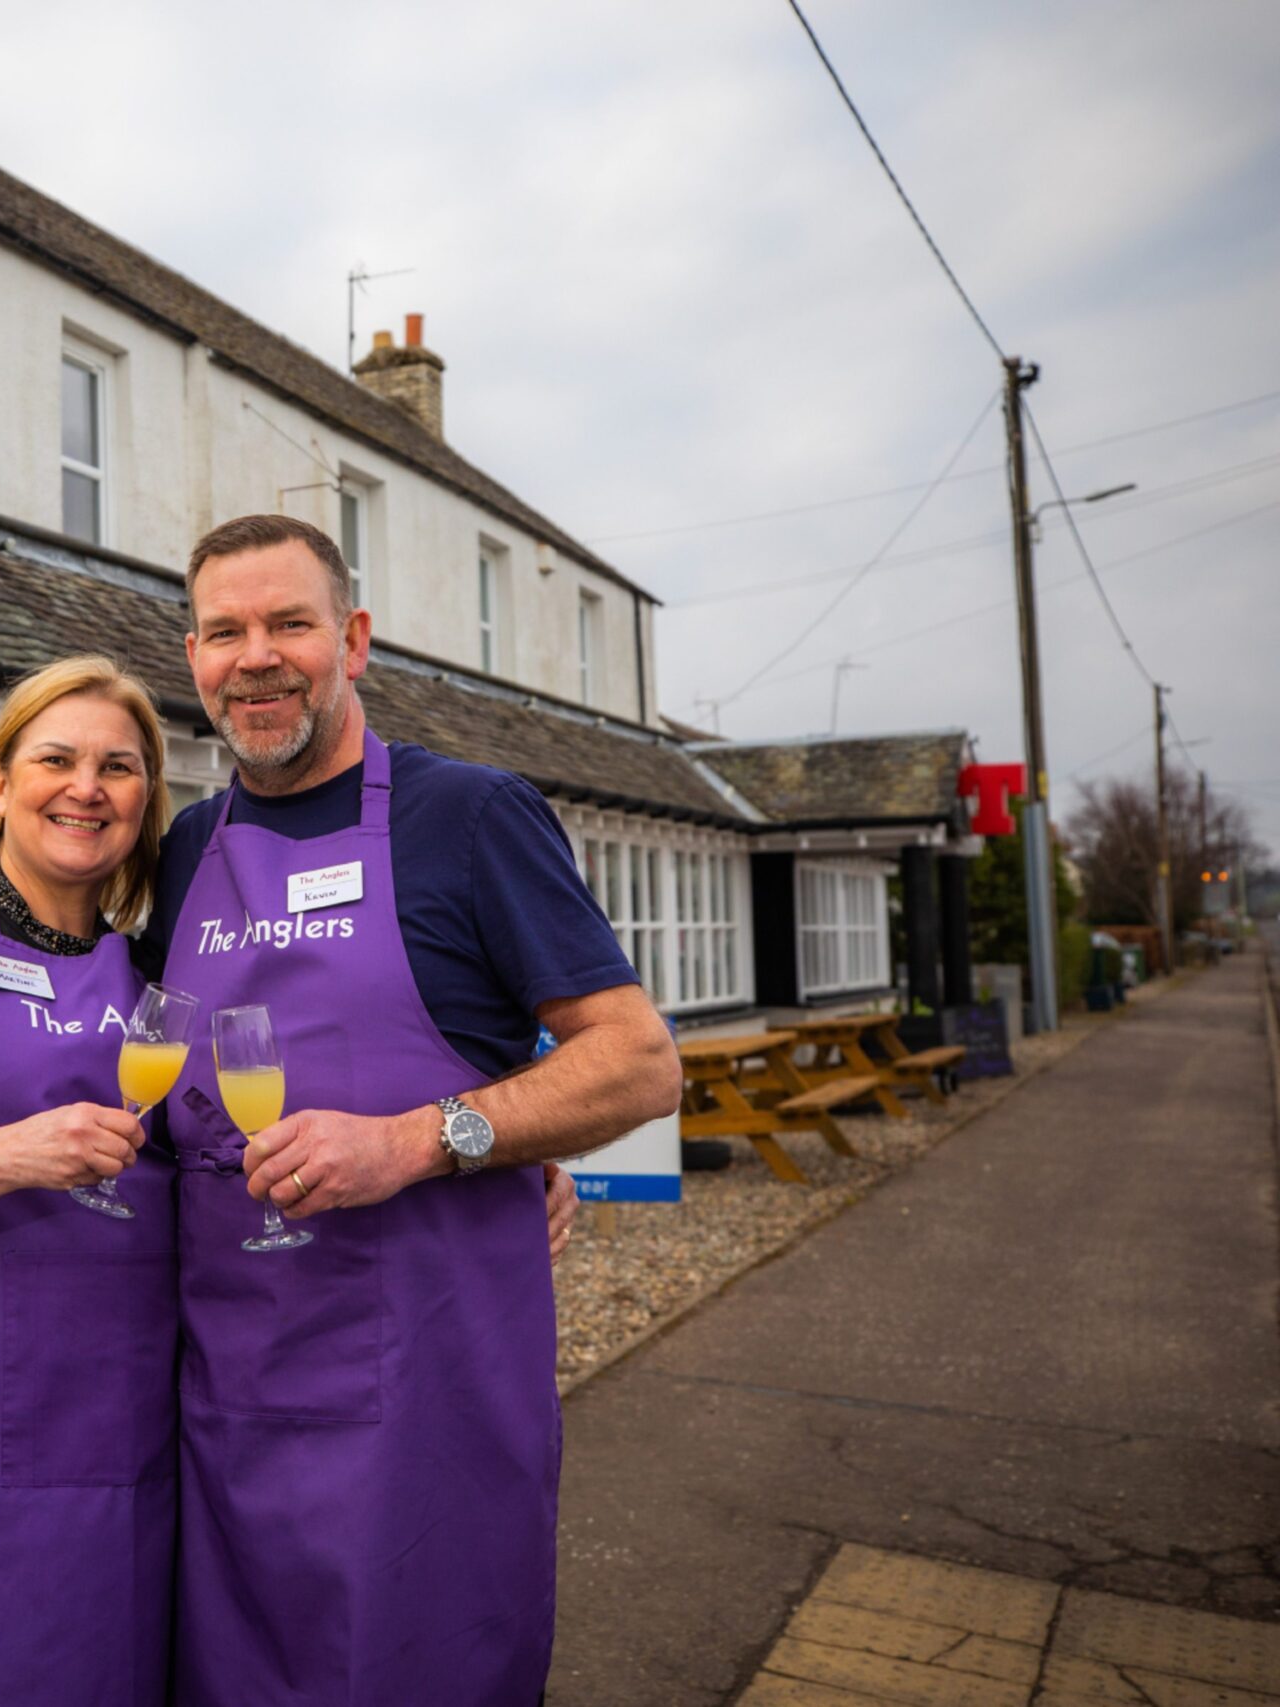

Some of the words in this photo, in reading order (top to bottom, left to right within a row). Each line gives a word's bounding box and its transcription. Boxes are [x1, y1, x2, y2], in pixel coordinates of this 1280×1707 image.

[299, 876, 314, 885] The
[198, 918, 236, 955] The
[239, 909, 355, 949] Anglers
[21, 999, 84, 1035] The
